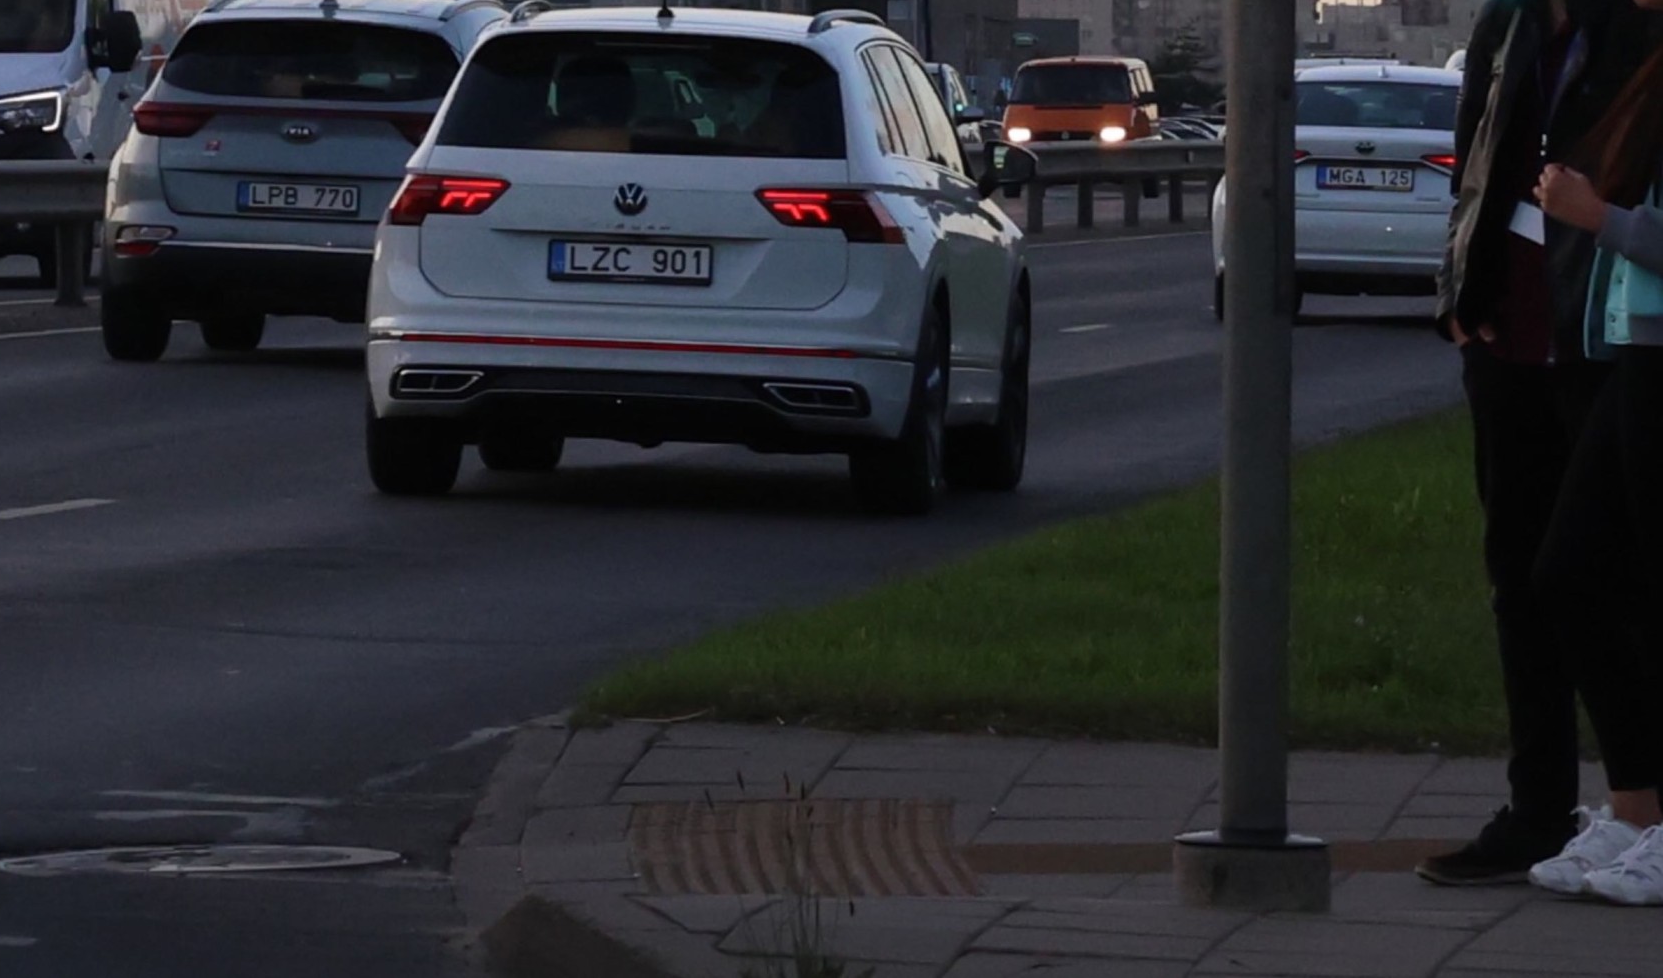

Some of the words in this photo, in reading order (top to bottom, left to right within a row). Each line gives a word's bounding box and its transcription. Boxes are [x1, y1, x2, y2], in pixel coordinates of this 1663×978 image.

[1329, 168, 1366, 184] MGA
[1380, 170, 1409, 186] 125
[252, 185, 298, 206] LPB
[314, 188, 354, 209] 770
[570, 245, 632, 272] LZC
[653, 249, 702, 275] 901
